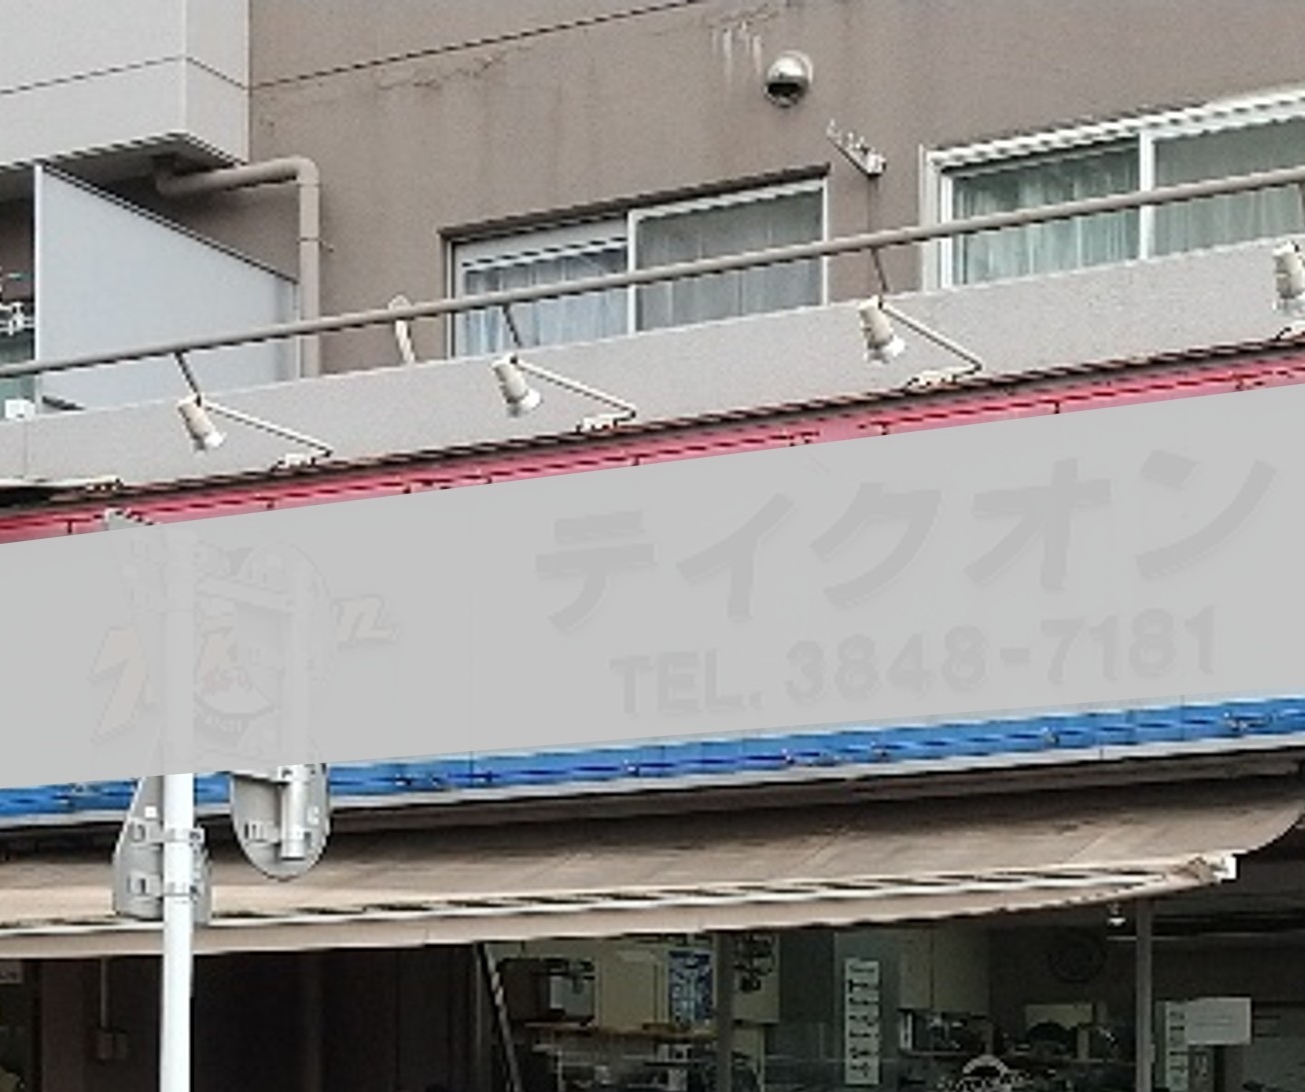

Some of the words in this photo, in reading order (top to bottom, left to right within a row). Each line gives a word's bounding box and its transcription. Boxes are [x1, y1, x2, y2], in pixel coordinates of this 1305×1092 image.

[534, 447, 1278, 634] テイクオン
[784, 605, 1219, 705] 3848-7181
